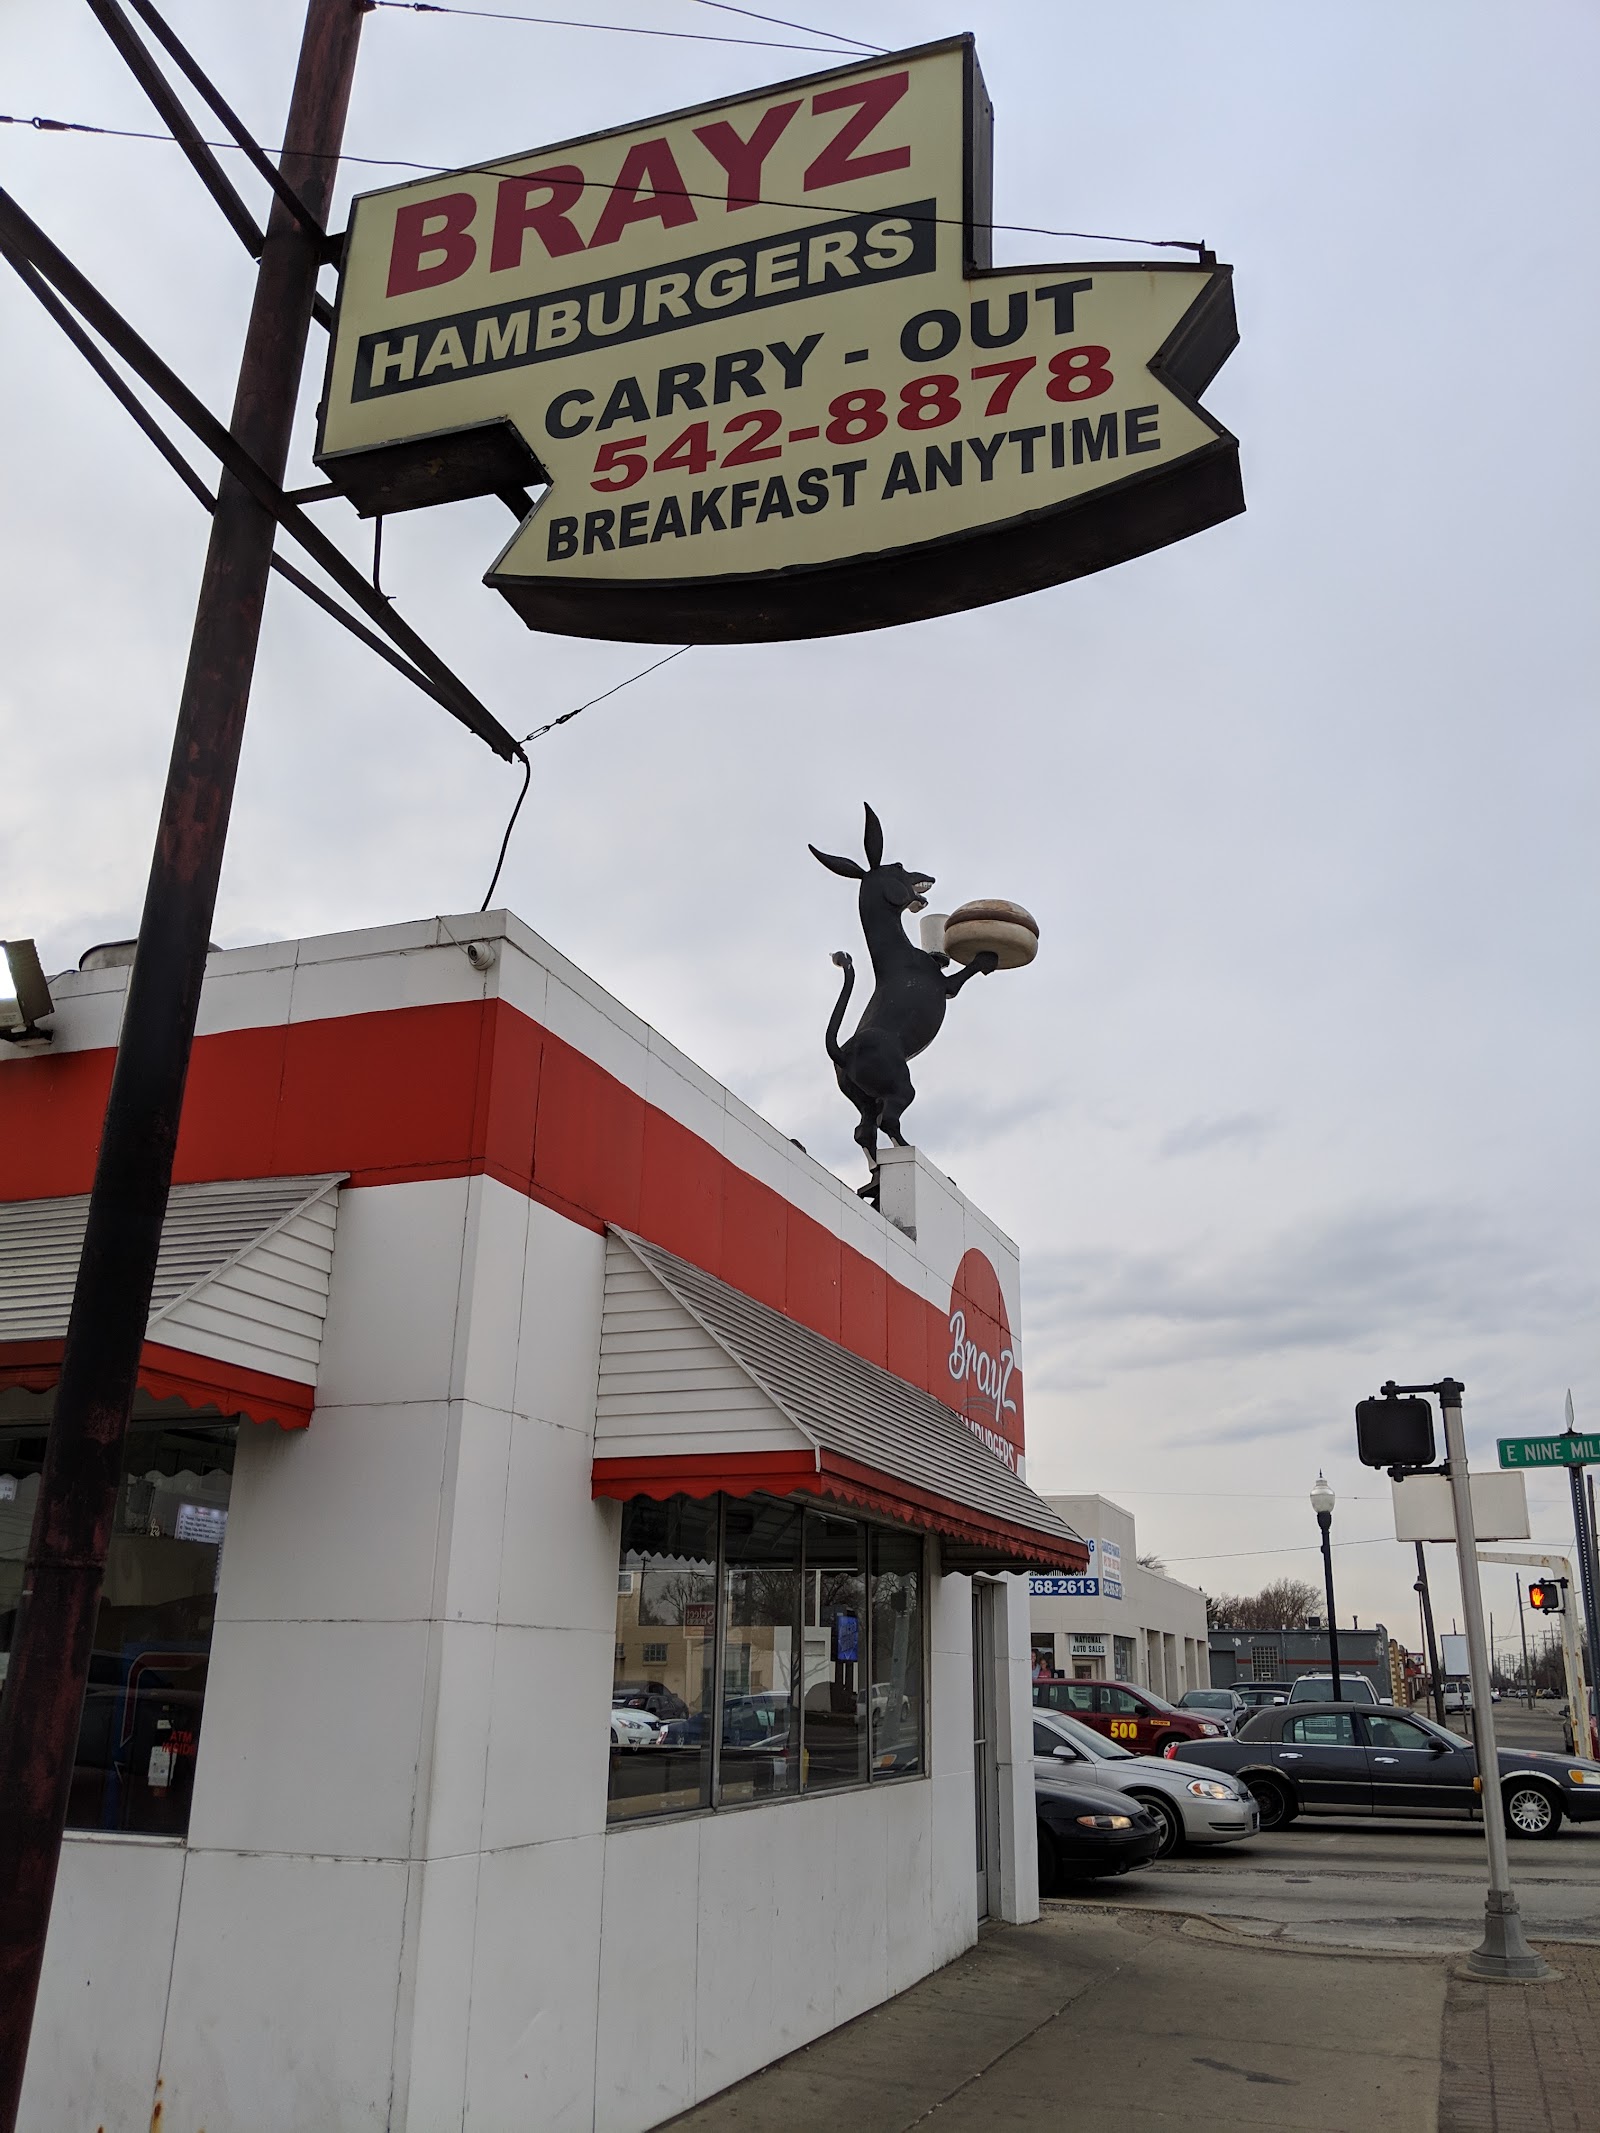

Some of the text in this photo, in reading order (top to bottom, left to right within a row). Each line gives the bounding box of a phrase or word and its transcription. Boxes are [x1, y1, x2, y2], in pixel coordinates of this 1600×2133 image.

[386, 71, 911, 298] BRAYZ
[369, 217, 914, 387] HAMBURGERS
[546, 333, 823, 439] CARRY
[900, 278, 1093, 364] OUT
[590, 345, 1114, 493] 542-8878
[548, 404, 1160, 562] BREAKFAST ANYTIME
[1506, 1440, 1600, 1462] E NINE MIL
[1029, 1580, 1096, 1594] 268-2613
[1072, 1645, 1105, 1653] AUTO SALES
[1074, 1635, 1102, 1644] NATIONAL
[169, 1730, 193, 1743] ATM
[1110, 1722, 1138, 1739] 500
